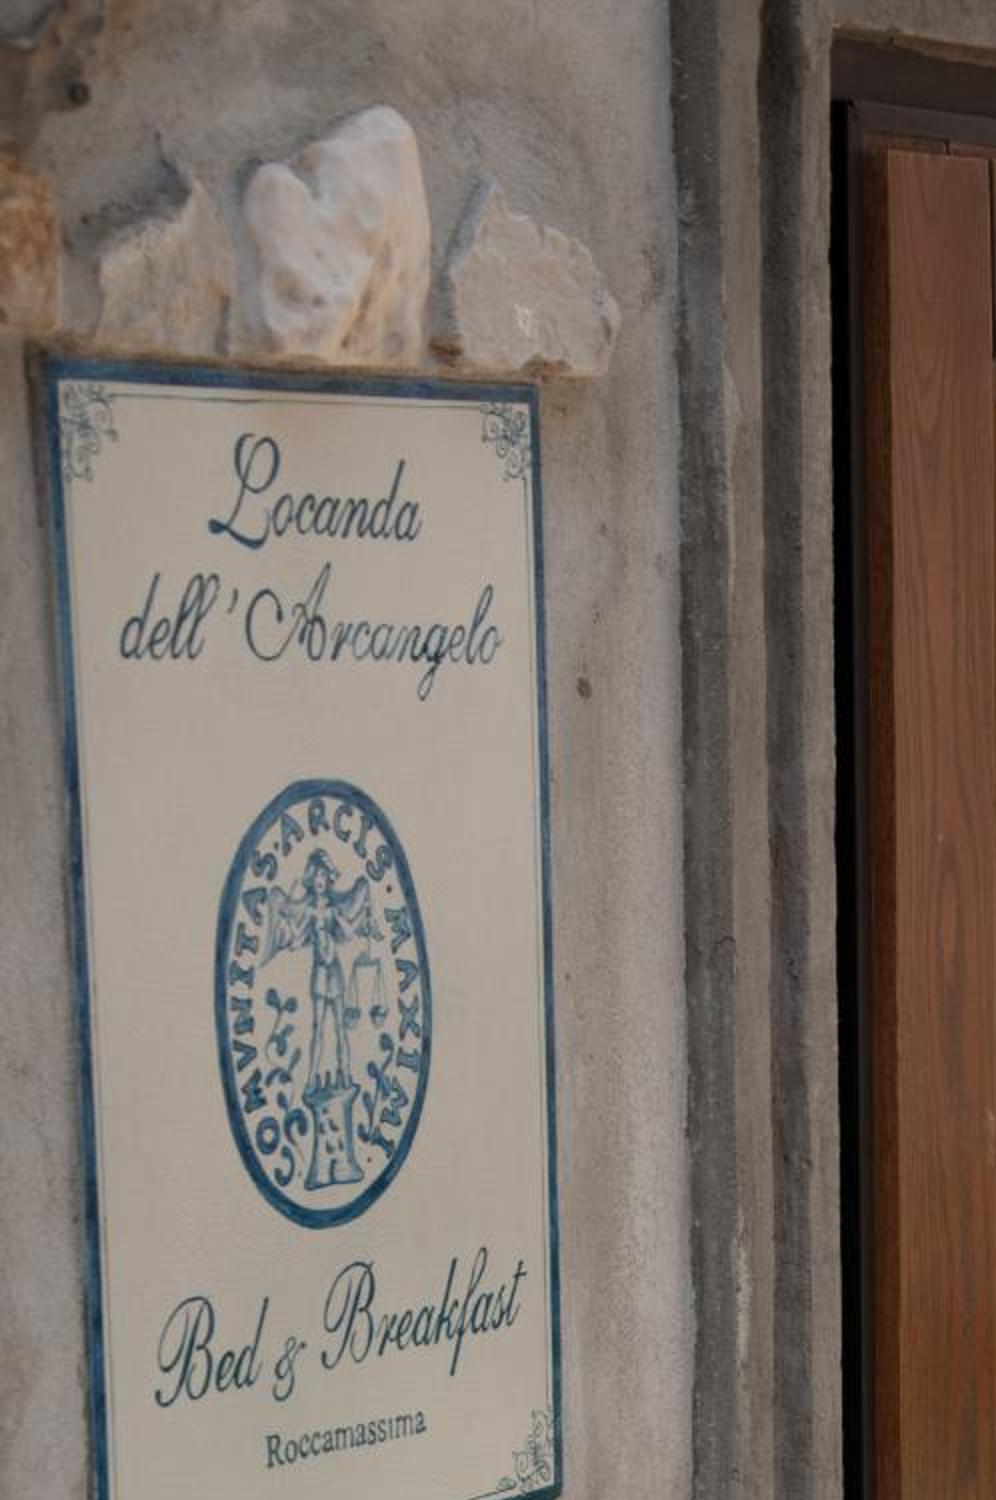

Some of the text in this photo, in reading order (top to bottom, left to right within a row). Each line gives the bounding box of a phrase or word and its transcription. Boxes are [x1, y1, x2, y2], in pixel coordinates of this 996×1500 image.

[207, 432, 424, 550] Locanda
[154, 1245, 528, 1408] Bed & Breakfast
[265, 1409, 427, 1469] Roccamassima
